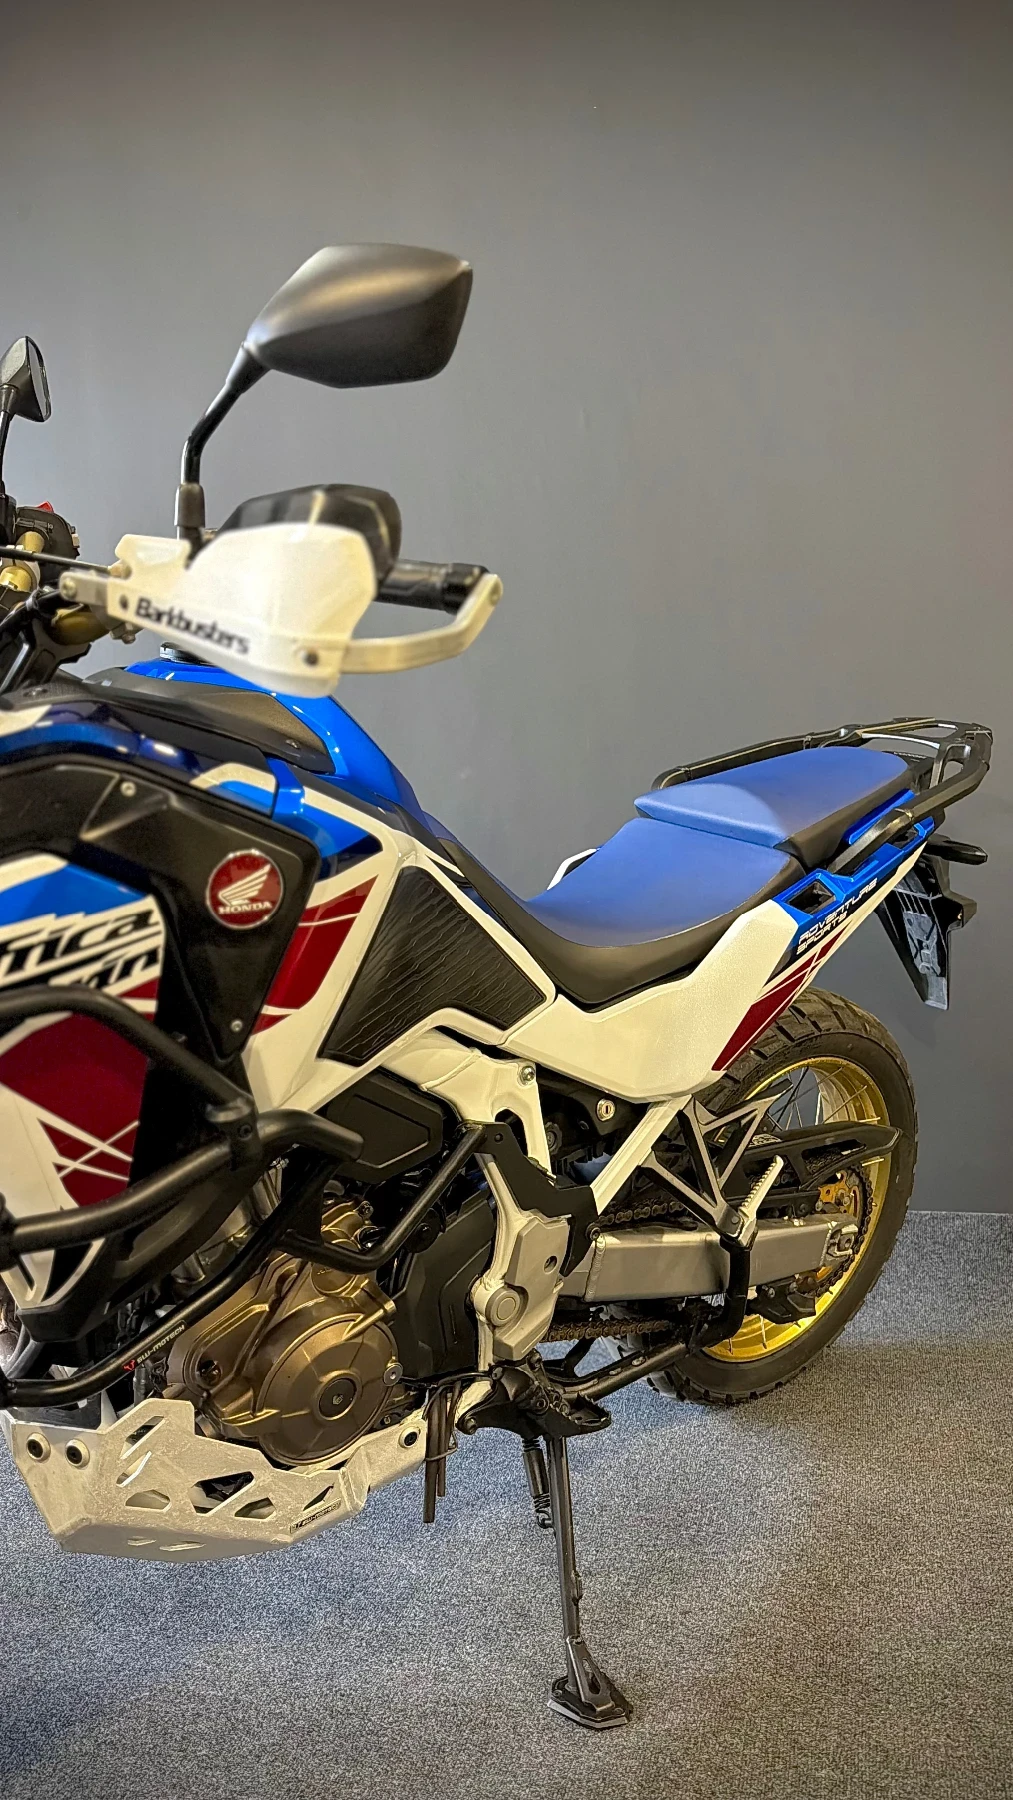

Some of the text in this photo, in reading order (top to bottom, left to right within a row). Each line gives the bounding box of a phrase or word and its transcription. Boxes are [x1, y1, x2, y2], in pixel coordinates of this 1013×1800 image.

[136, 598, 250, 655] Barkbusters
[219, 901, 272, 915] HONDA
[799, 877, 878, 944] ADVENTURE
[796, 911, 848, 955] SPORTS
[137, 1324, 185, 1363] SW-MOTECH
